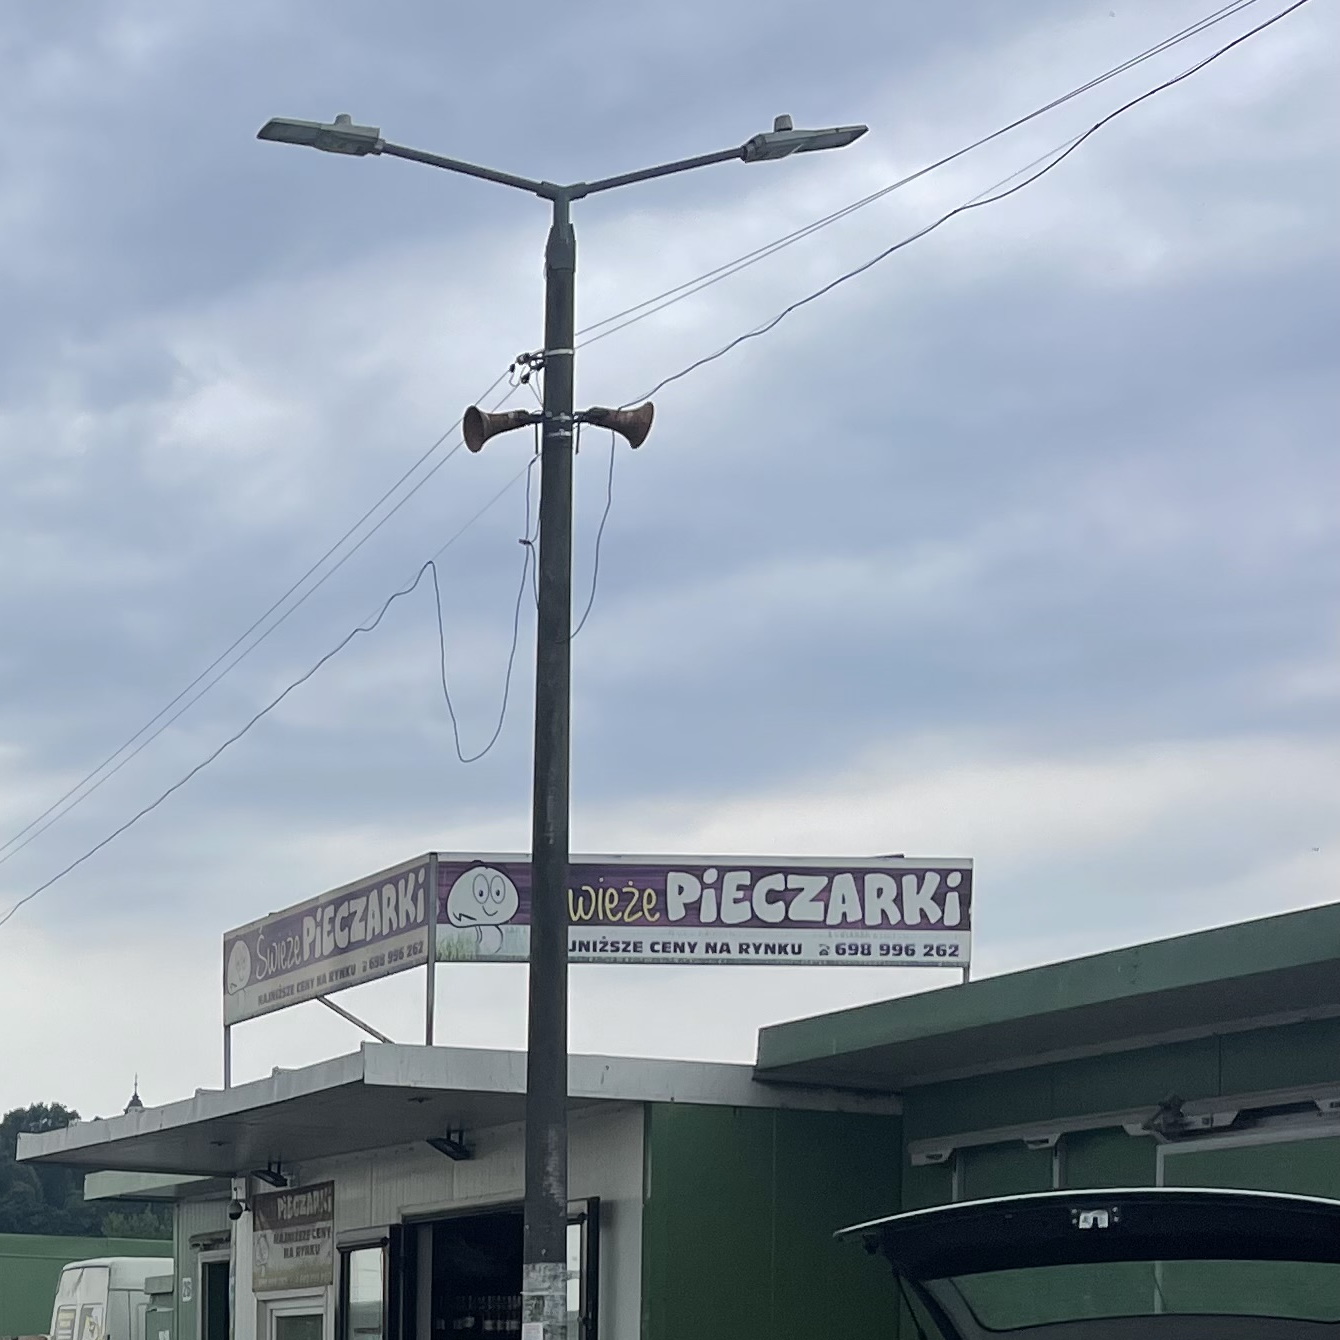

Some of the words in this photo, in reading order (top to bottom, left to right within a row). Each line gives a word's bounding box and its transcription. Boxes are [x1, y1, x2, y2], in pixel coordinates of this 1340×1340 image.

[569, 876, 660, 922] wieże
[569, 936, 643, 954] JNIŻSZE
[649, 941, 698, 955] CENY
[705, 942, 731, 955] NA
[738, 942, 802, 956] RYNKU
[835, 942, 872, 957] 698
[879, 943, 916, 957] 996
[923, 944, 960, 958] 262
